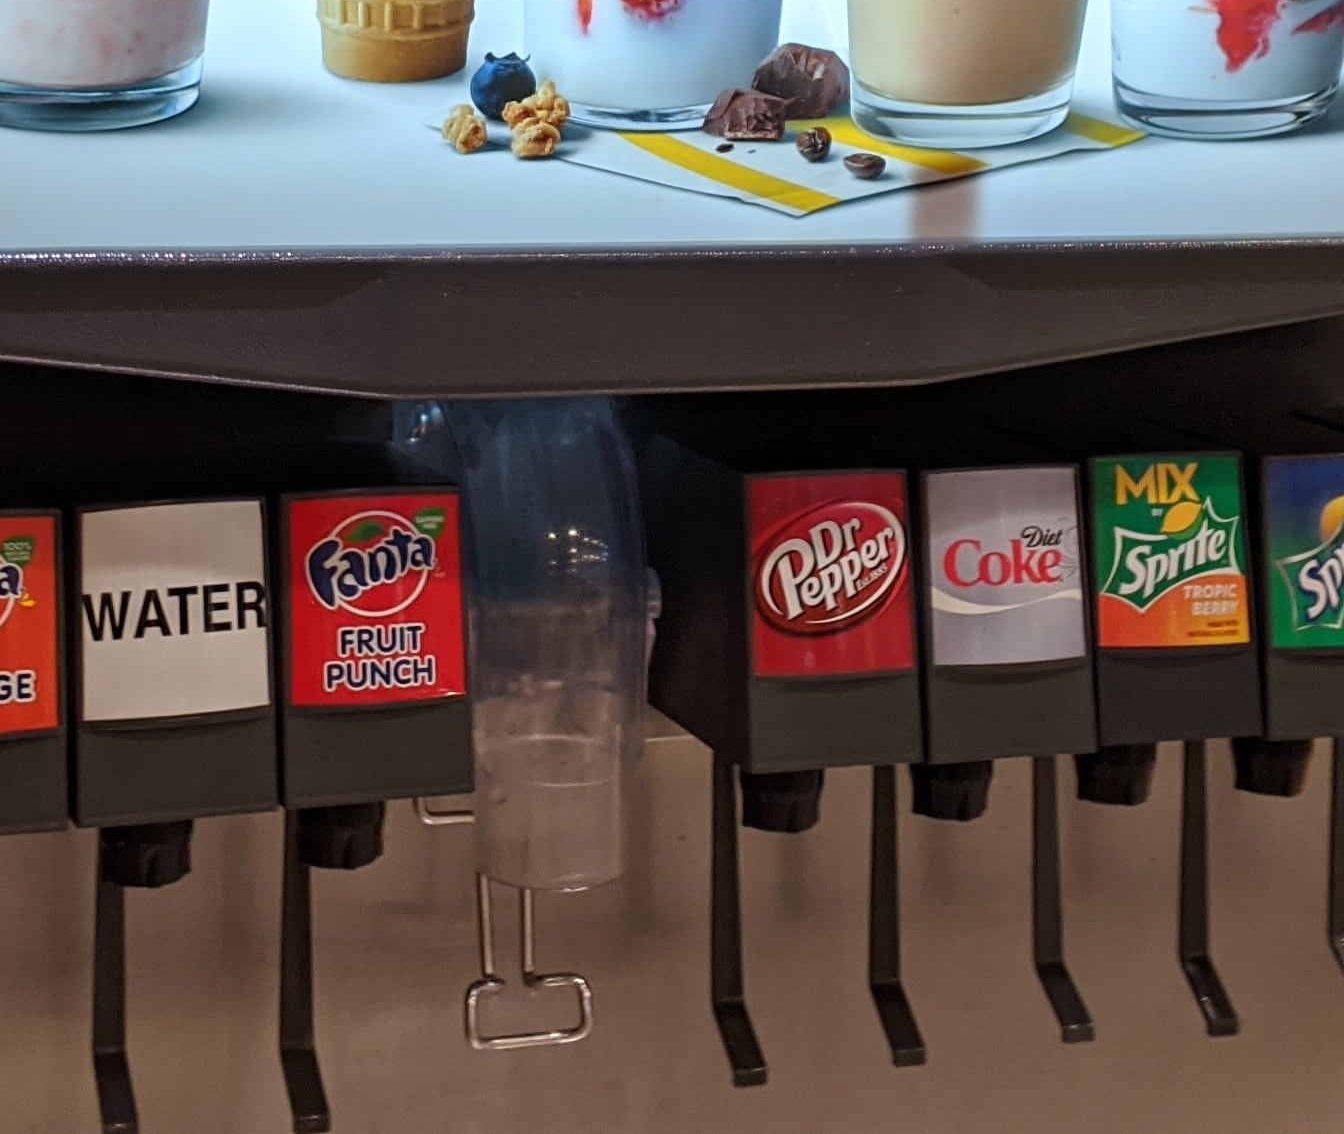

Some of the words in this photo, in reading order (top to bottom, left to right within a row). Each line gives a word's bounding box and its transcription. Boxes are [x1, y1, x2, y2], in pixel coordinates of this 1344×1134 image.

[1115, 462, 1200, 506] MIX
[809, 516, 862, 566] Dr
[1020, 526, 1062, 549] Diet
[305, 526, 438, 610] Fanta
[761, 523, 898, 621] Pepper
[943, 538, 1065, 588] Coke
[1118, 524, 1227, 599] Sprite
[82, 580, 269, 643] WATER
[1183, 584, 1239, 601] TROPIC
[1191, 600, 1239, 617] BERRY
[336, 623, 426, 660] FRUIT
[322, 656, 436, 694] PUNCH
